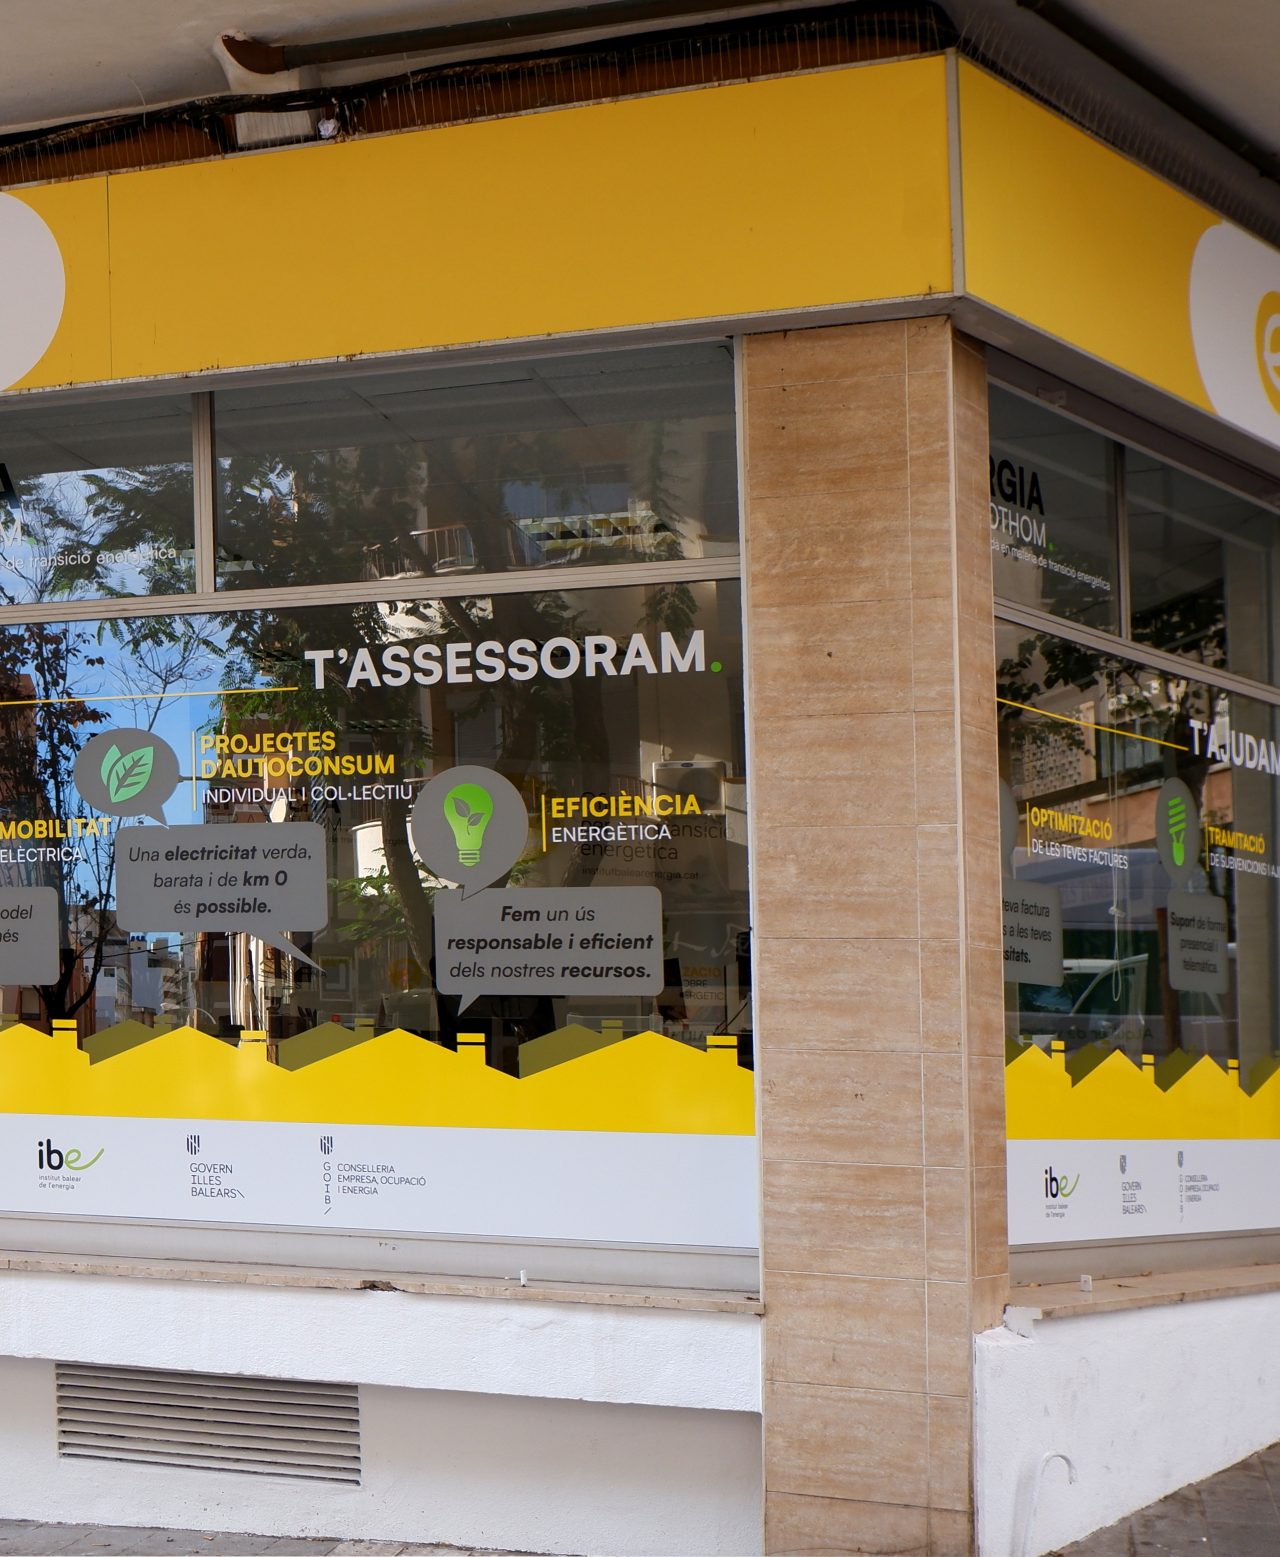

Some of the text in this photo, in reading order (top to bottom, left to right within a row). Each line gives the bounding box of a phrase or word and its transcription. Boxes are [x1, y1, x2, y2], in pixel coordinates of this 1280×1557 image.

[6, 555, 24, 570] de
[200, 730, 337, 755] PROJECTES
[201, 754, 396, 779] D'AUTOCONSUM
[202, 786, 298, 804] INDIVIDUAL
[551, 790, 703, 819] EFICIÈNCIA
[551, 821, 672, 843] ENERGÈTICA
[1031, 806, 1113, 841] OPTIMITZACIÓ
[0, 845, 84, 863] ELÈCTRICA
[128, 843, 312, 862] Una electricitat verda,
[1032, 838, 1129, 870] DE LES TEVES FACTURES
[153, 871, 204, 889] barata
[217, 870, 239, 888] de
[242, 869, 270, 887] km
[173, 897, 272, 918] és possible.
[500, 905, 596, 923] Fem un ús
[1021, 898, 1050, 917] factura
[1017, 920, 1029, 939] les
[1031, 926, 1053, 942] teves
[447, 932, 654, 955] responsable i eficient
[1003, 945, 1031, 964] sitats.
[450, 961, 651, 979] dels nostres recursos.
[37, 1138, 105, 1171] ibe
[189, 1162, 233, 1174] GOVERN
[337, 1163, 396, 1174] CONSELLERIA
[62, 1174, 82, 1182] balear
[191, 1174, 222, 1186] ILLES
[380, 1175, 427, 1187] OCUPACIÓ
[1044, 1166, 1080, 1199] ibe
[342, 1186, 379, 1195] ENERGIA
